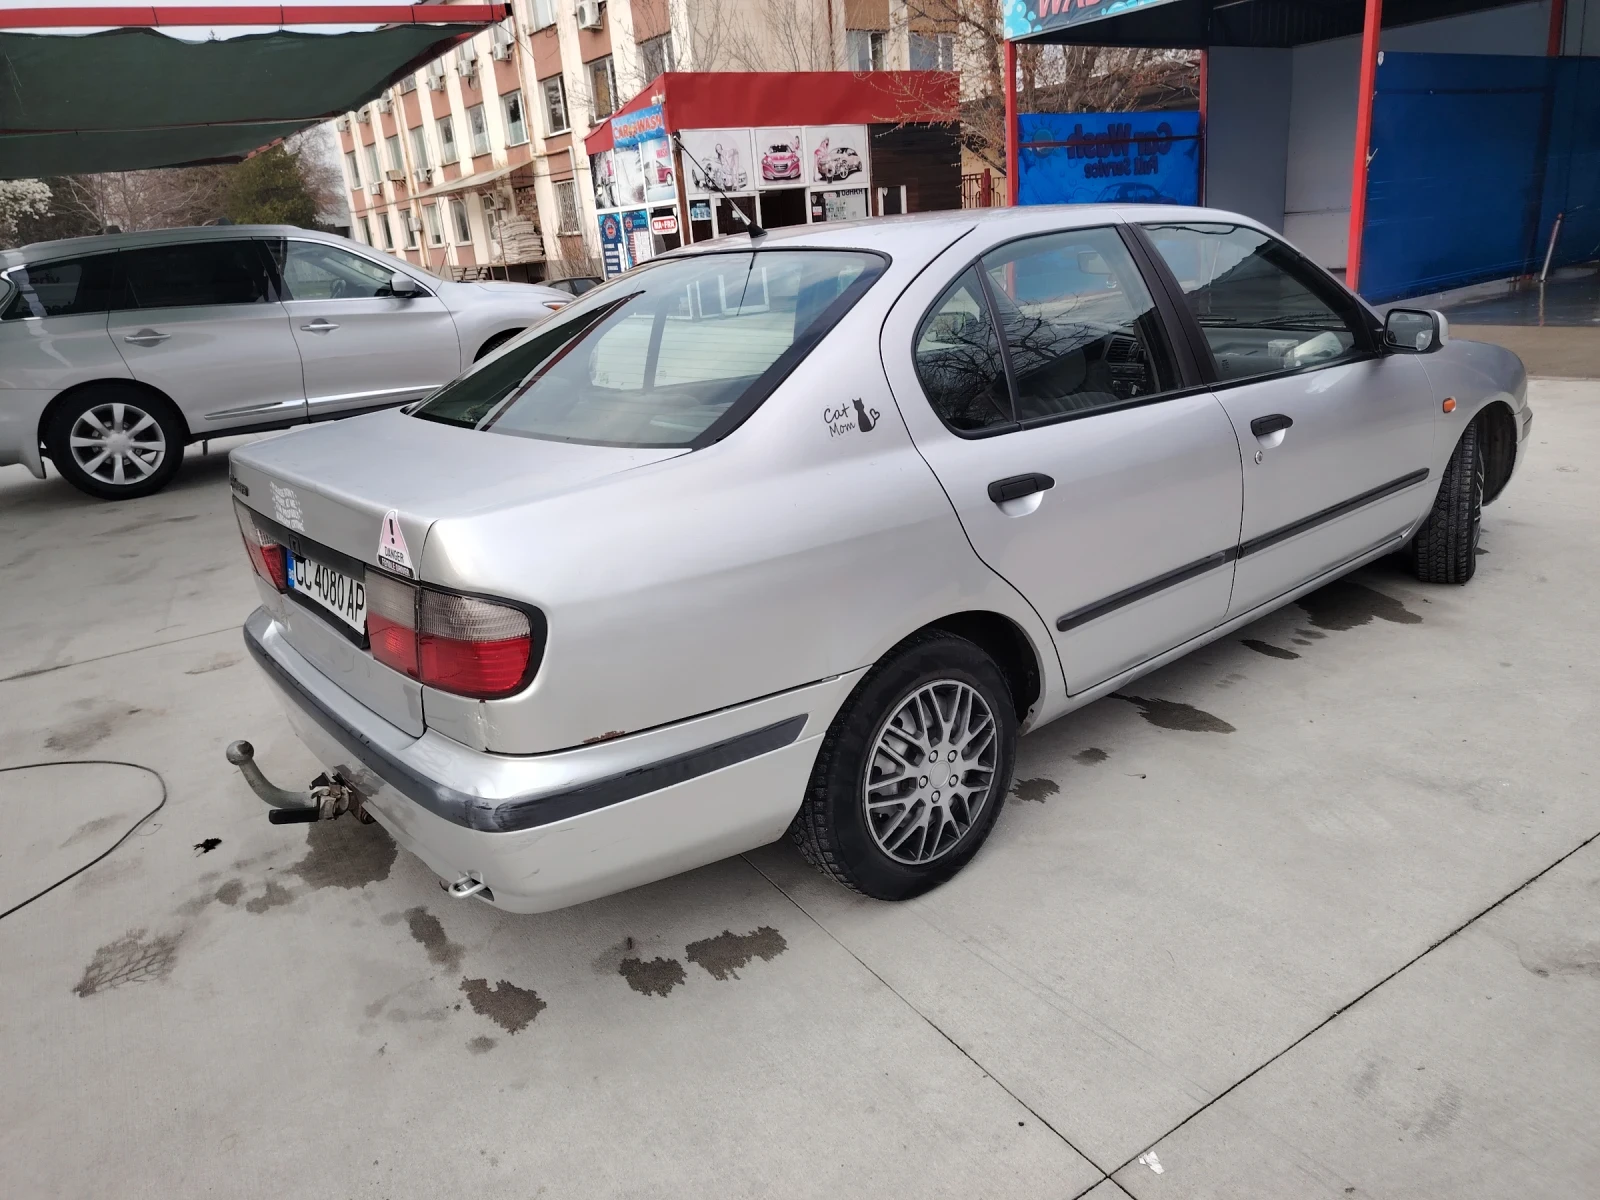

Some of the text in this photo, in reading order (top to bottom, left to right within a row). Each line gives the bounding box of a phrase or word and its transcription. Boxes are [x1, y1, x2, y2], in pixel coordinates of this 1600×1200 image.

[613, 114, 663, 139] CAR WASH
[824, 403, 850, 424] Cat
[829, 422, 856, 438] Mom
[384, 546, 404, 564] DANGER
[314, 564, 345, 612] 4080
[346, 578, 365, 622] AP
